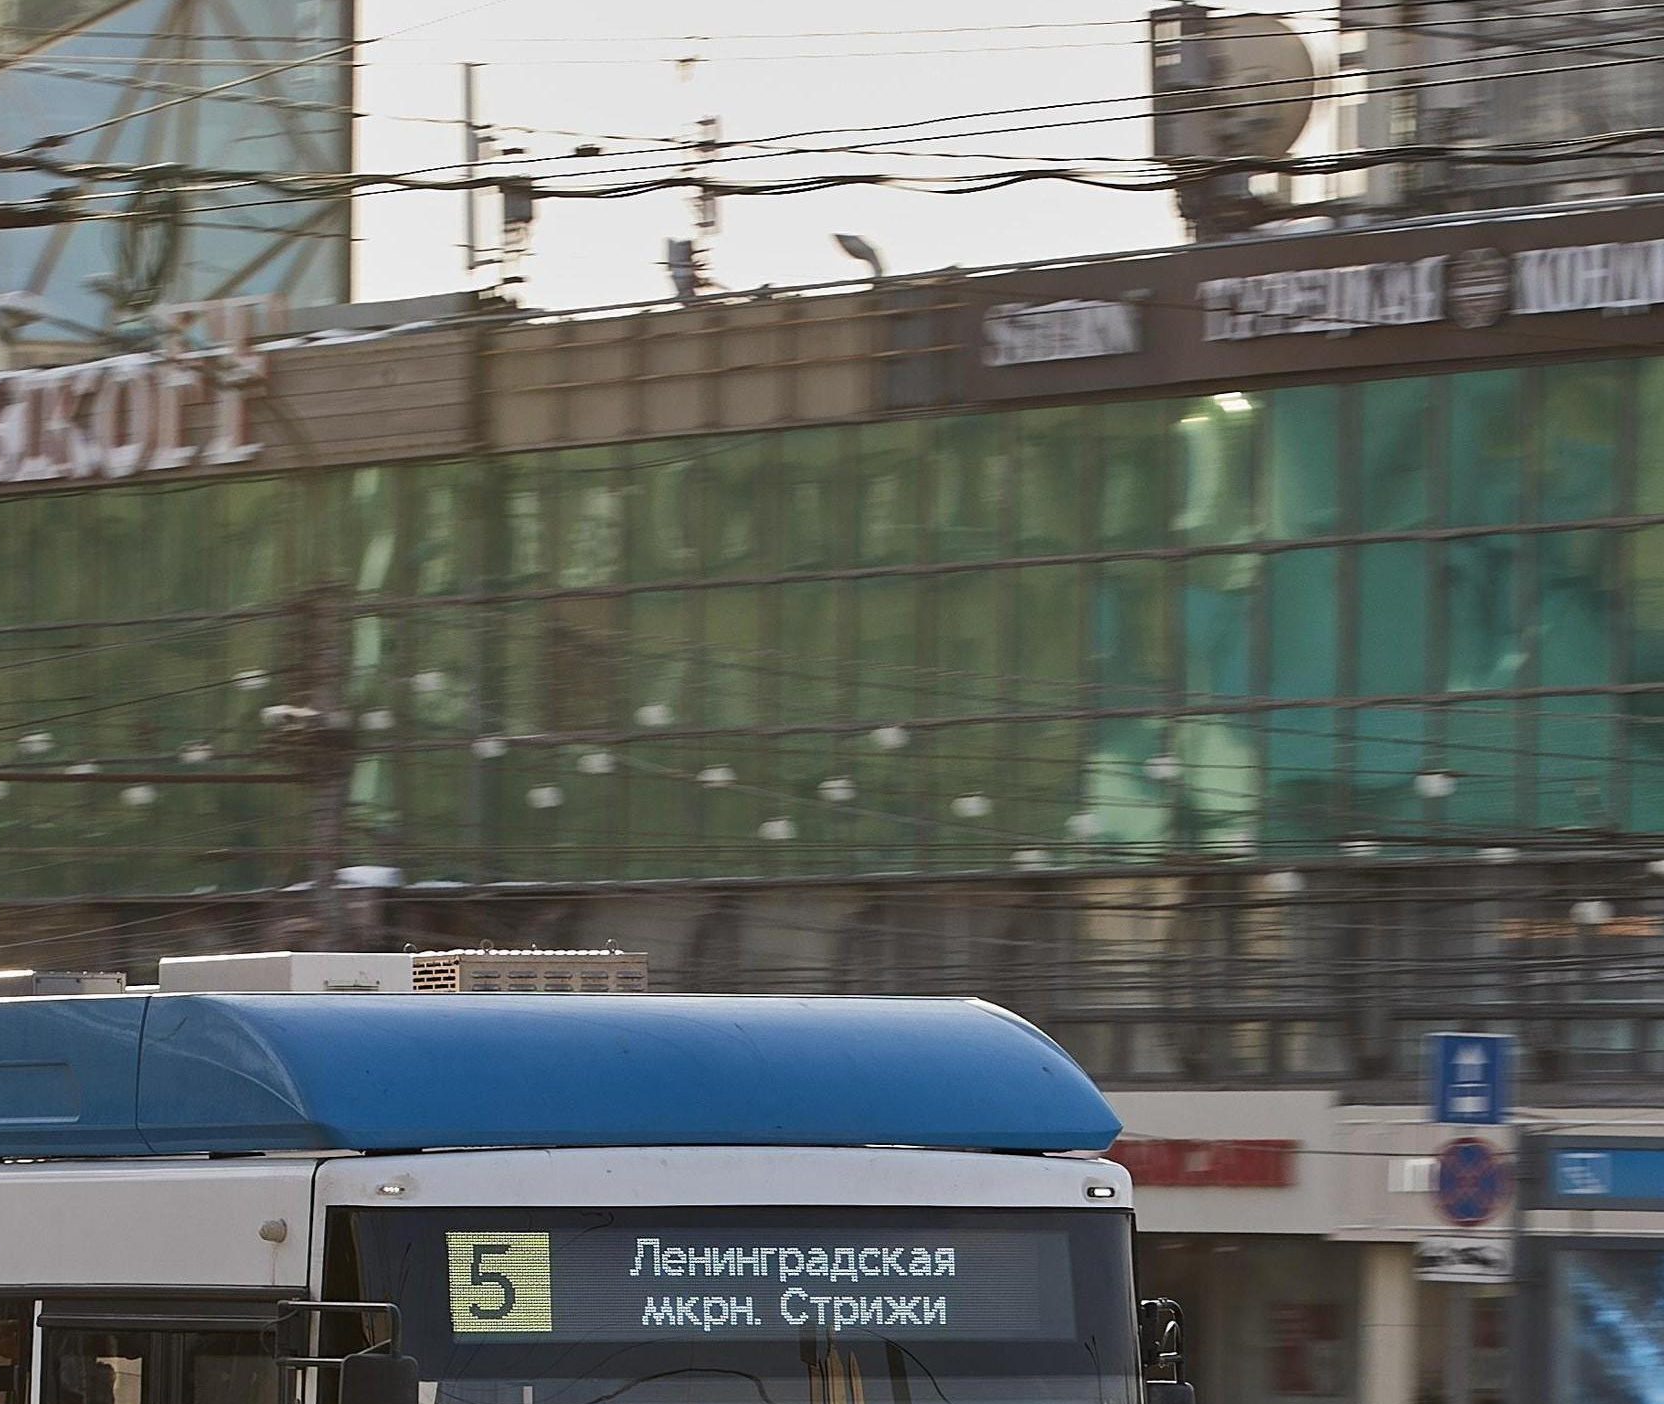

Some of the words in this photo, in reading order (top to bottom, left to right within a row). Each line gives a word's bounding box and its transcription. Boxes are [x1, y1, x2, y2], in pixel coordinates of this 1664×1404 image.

[468, 1242, 516, 1320] 5
[629, 1238, 956, 1281] Ленинградская
[642, 1295, 762, 1331] мкрн.
[780, 1288, 947, 1331] Стрижи
